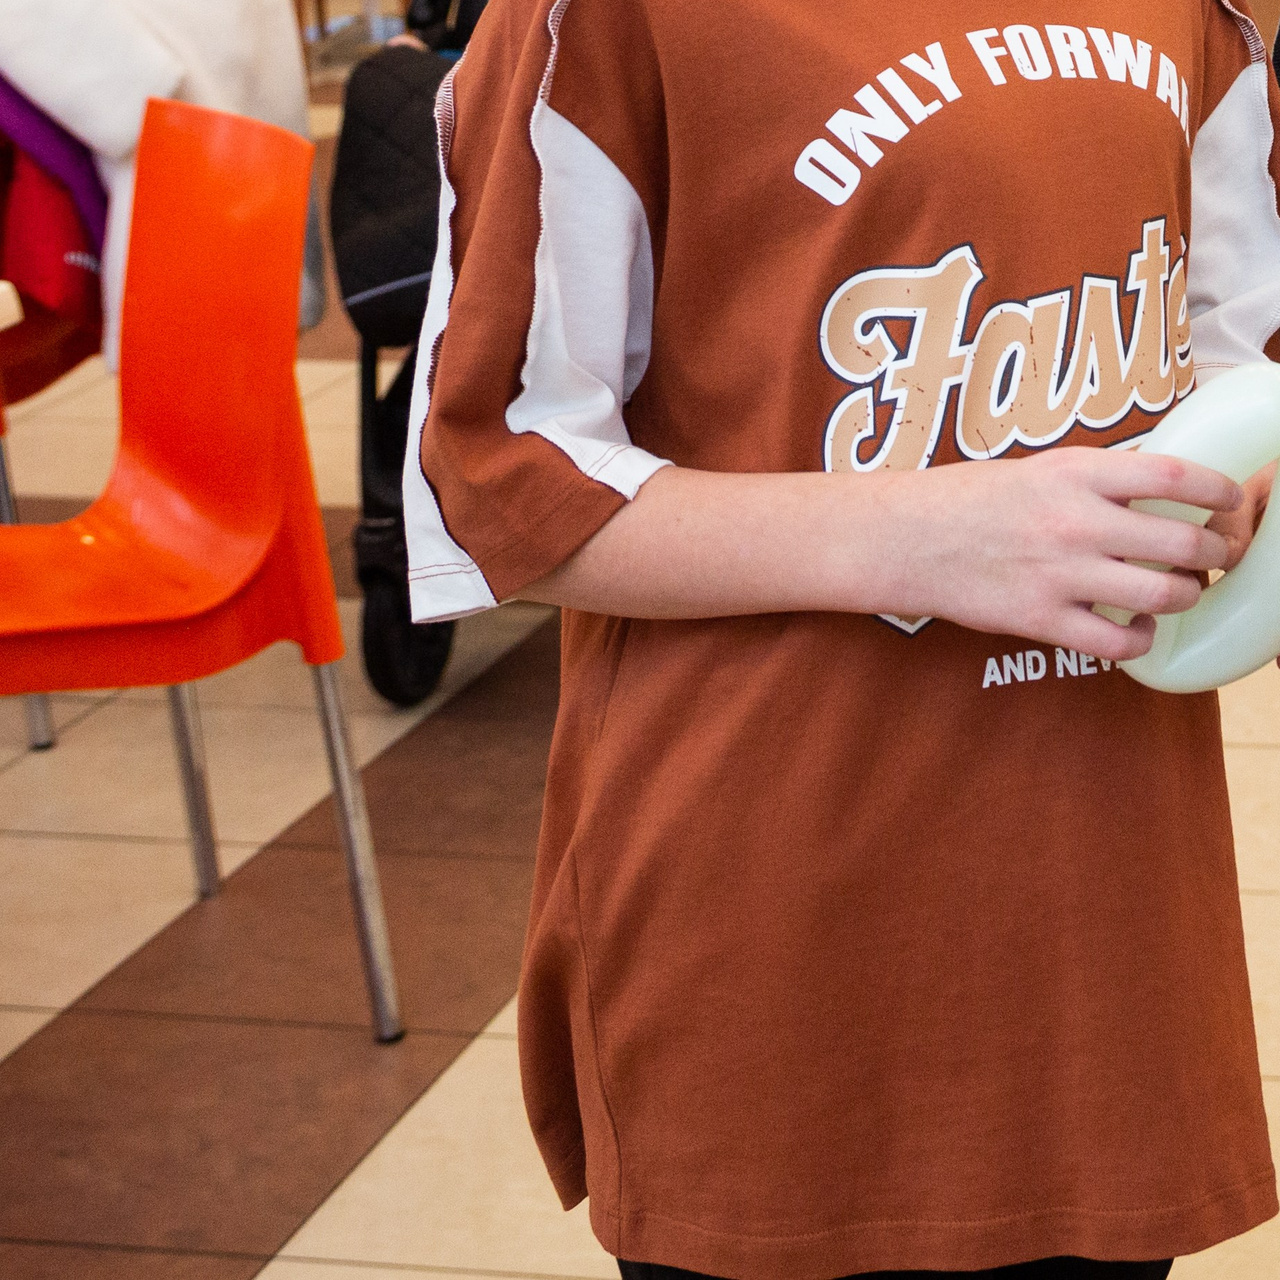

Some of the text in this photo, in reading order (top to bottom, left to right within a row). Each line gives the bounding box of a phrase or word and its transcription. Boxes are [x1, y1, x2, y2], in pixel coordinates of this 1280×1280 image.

[793, 41, 963, 207] ONLY
[819, 216, 1195, 473] Faste
[982, 649, 1047, 689] AND
